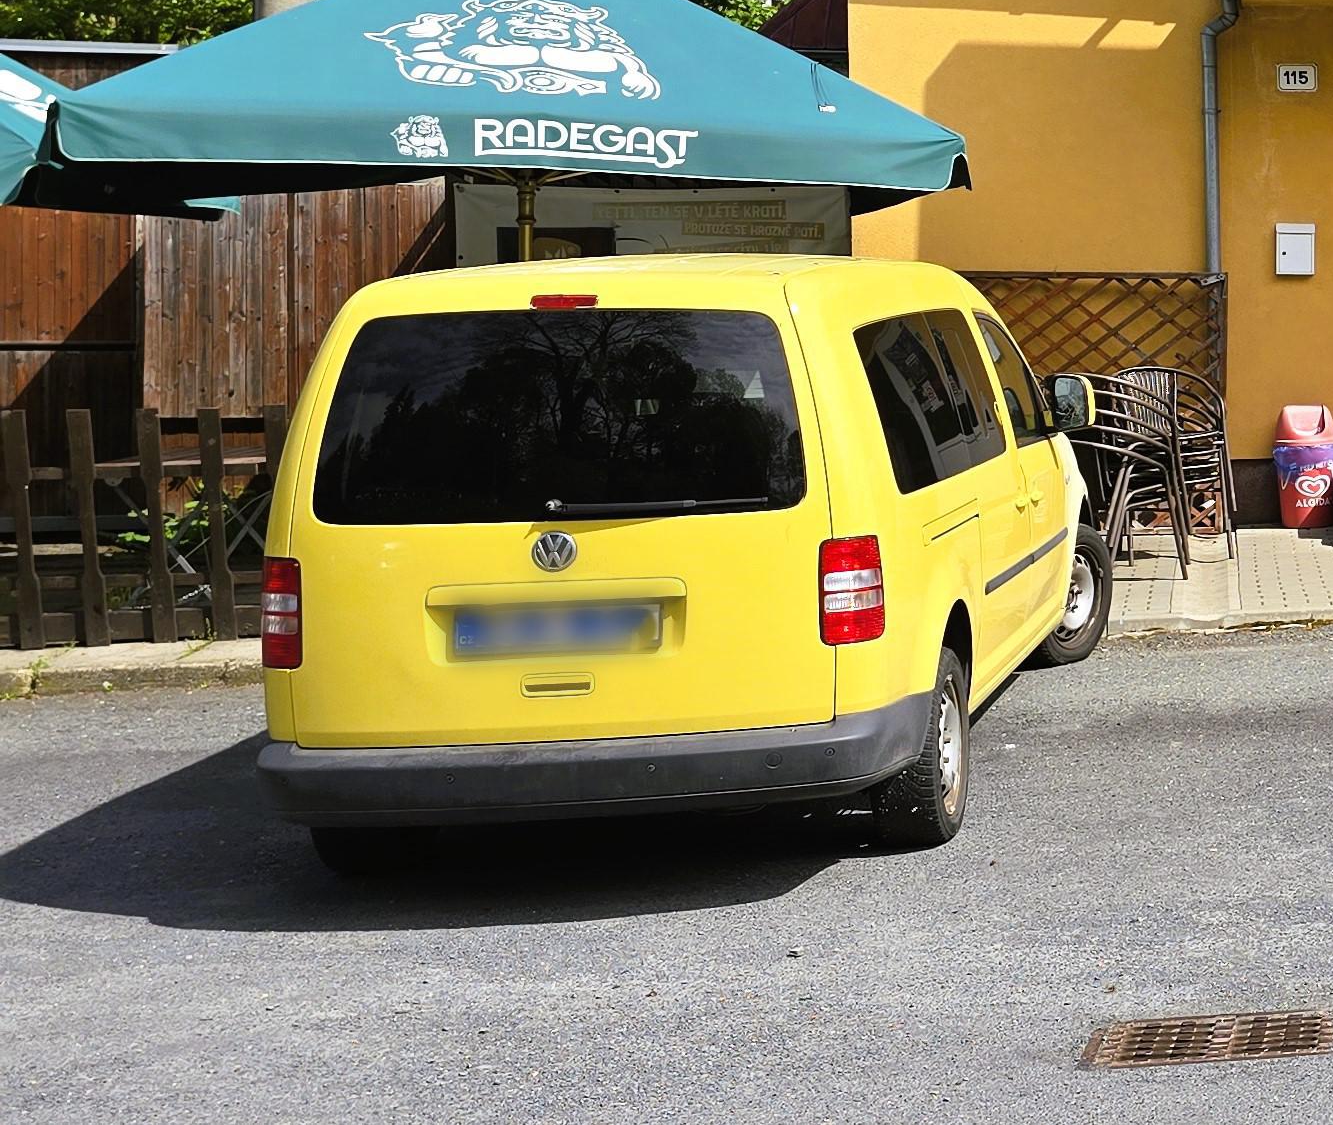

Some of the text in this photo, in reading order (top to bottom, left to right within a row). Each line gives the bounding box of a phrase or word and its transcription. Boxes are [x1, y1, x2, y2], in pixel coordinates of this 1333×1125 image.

[1283, 70, 1309, 85] 115
[473, 117, 699, 169] RADEGAST
[734, 224, 748, 236] SE
[1295, 497, 1333, 508] ALGIDA
